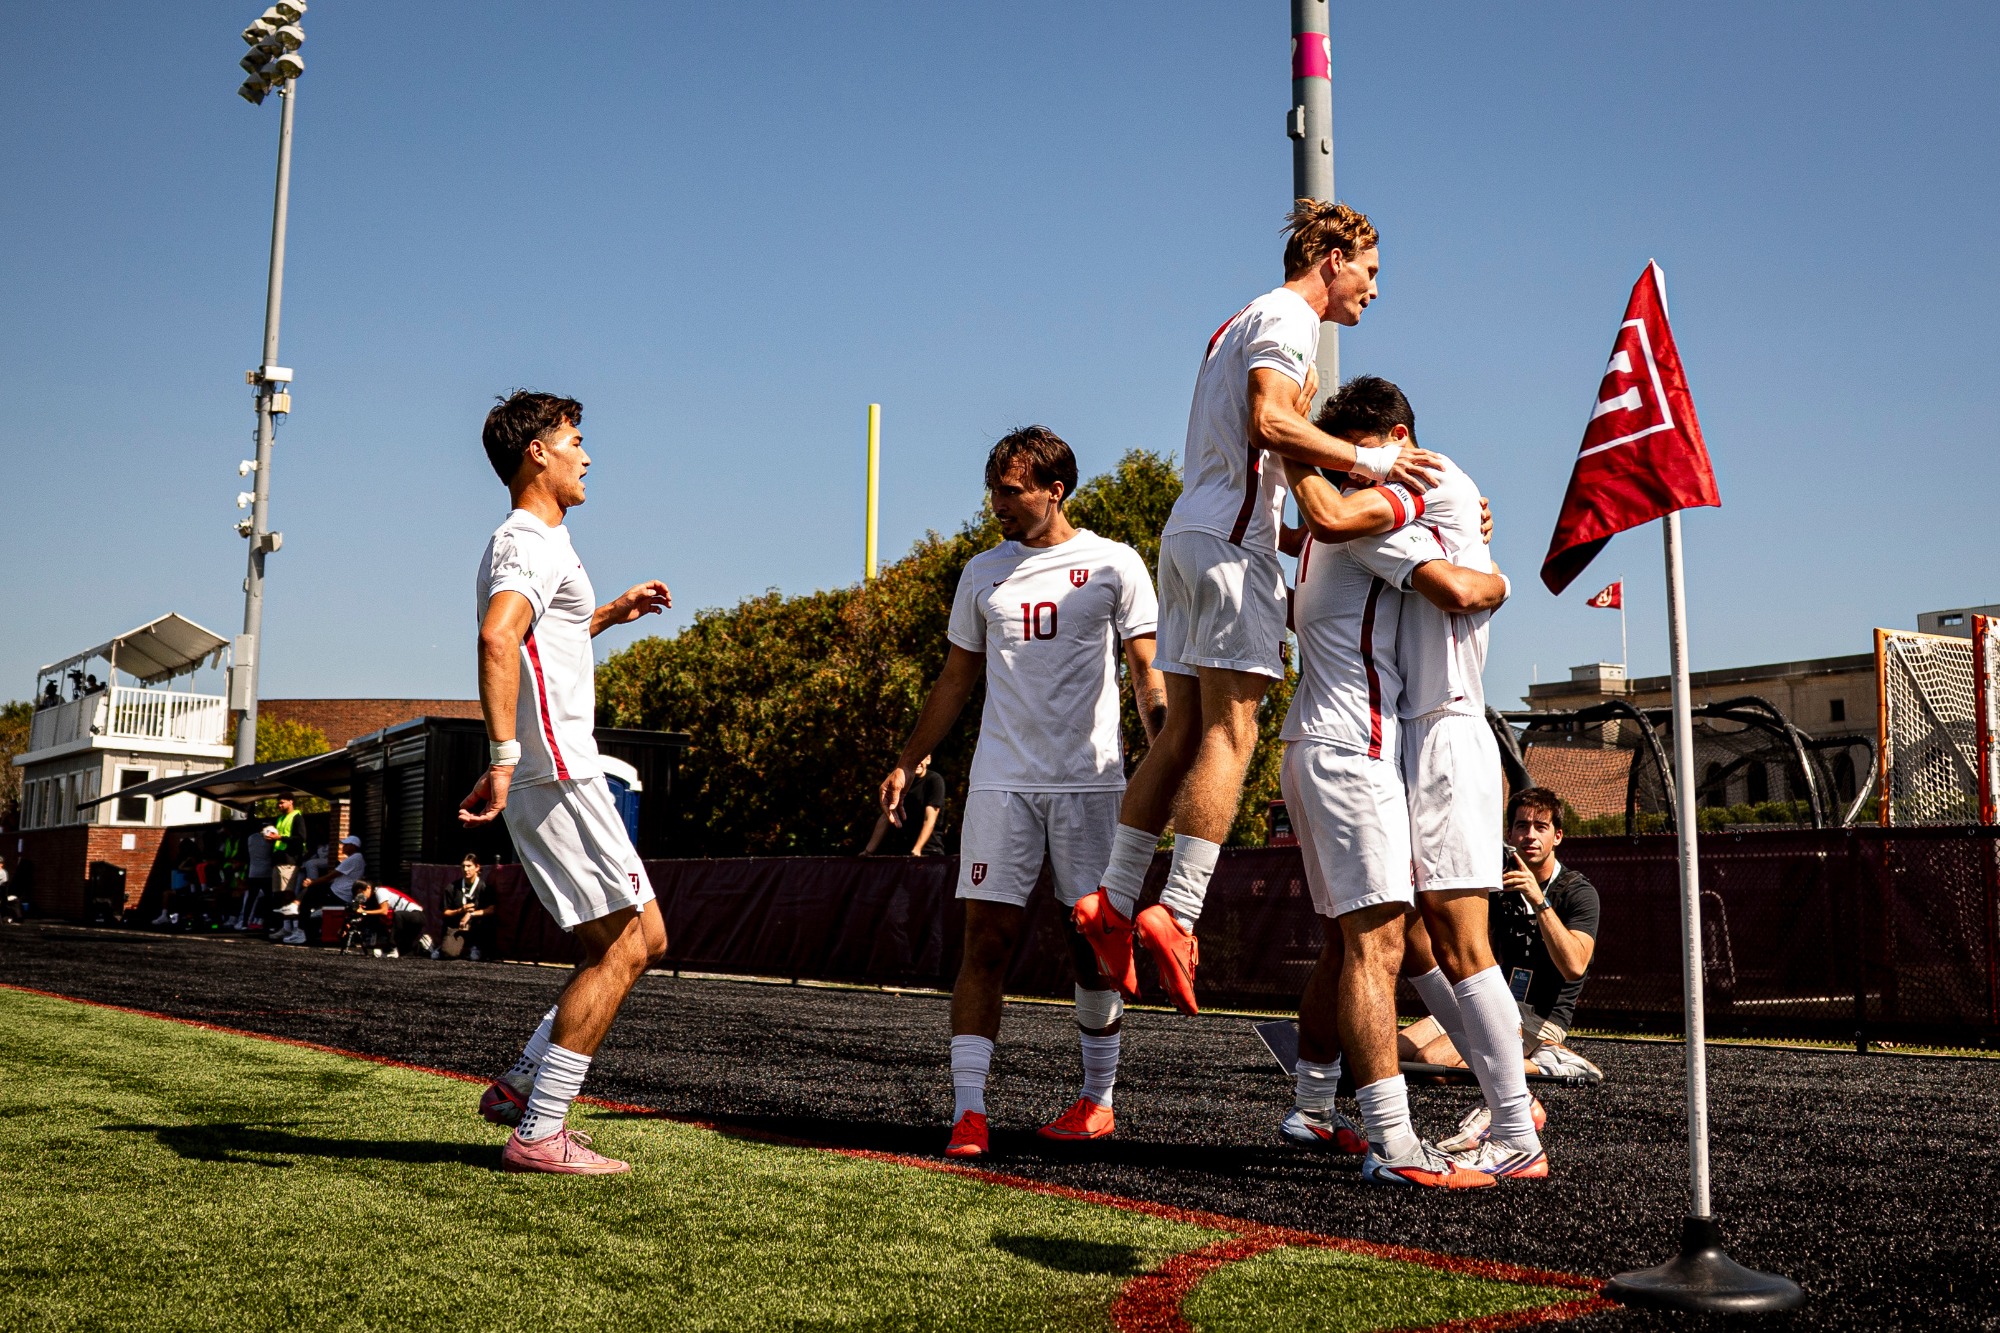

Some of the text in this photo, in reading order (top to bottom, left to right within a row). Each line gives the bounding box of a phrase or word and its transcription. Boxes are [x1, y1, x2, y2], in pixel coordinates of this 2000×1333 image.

[1072, 570, 1085, 583] H
[1020, 601, 1058, 641] 10
[972, 864, 984, 880] H
